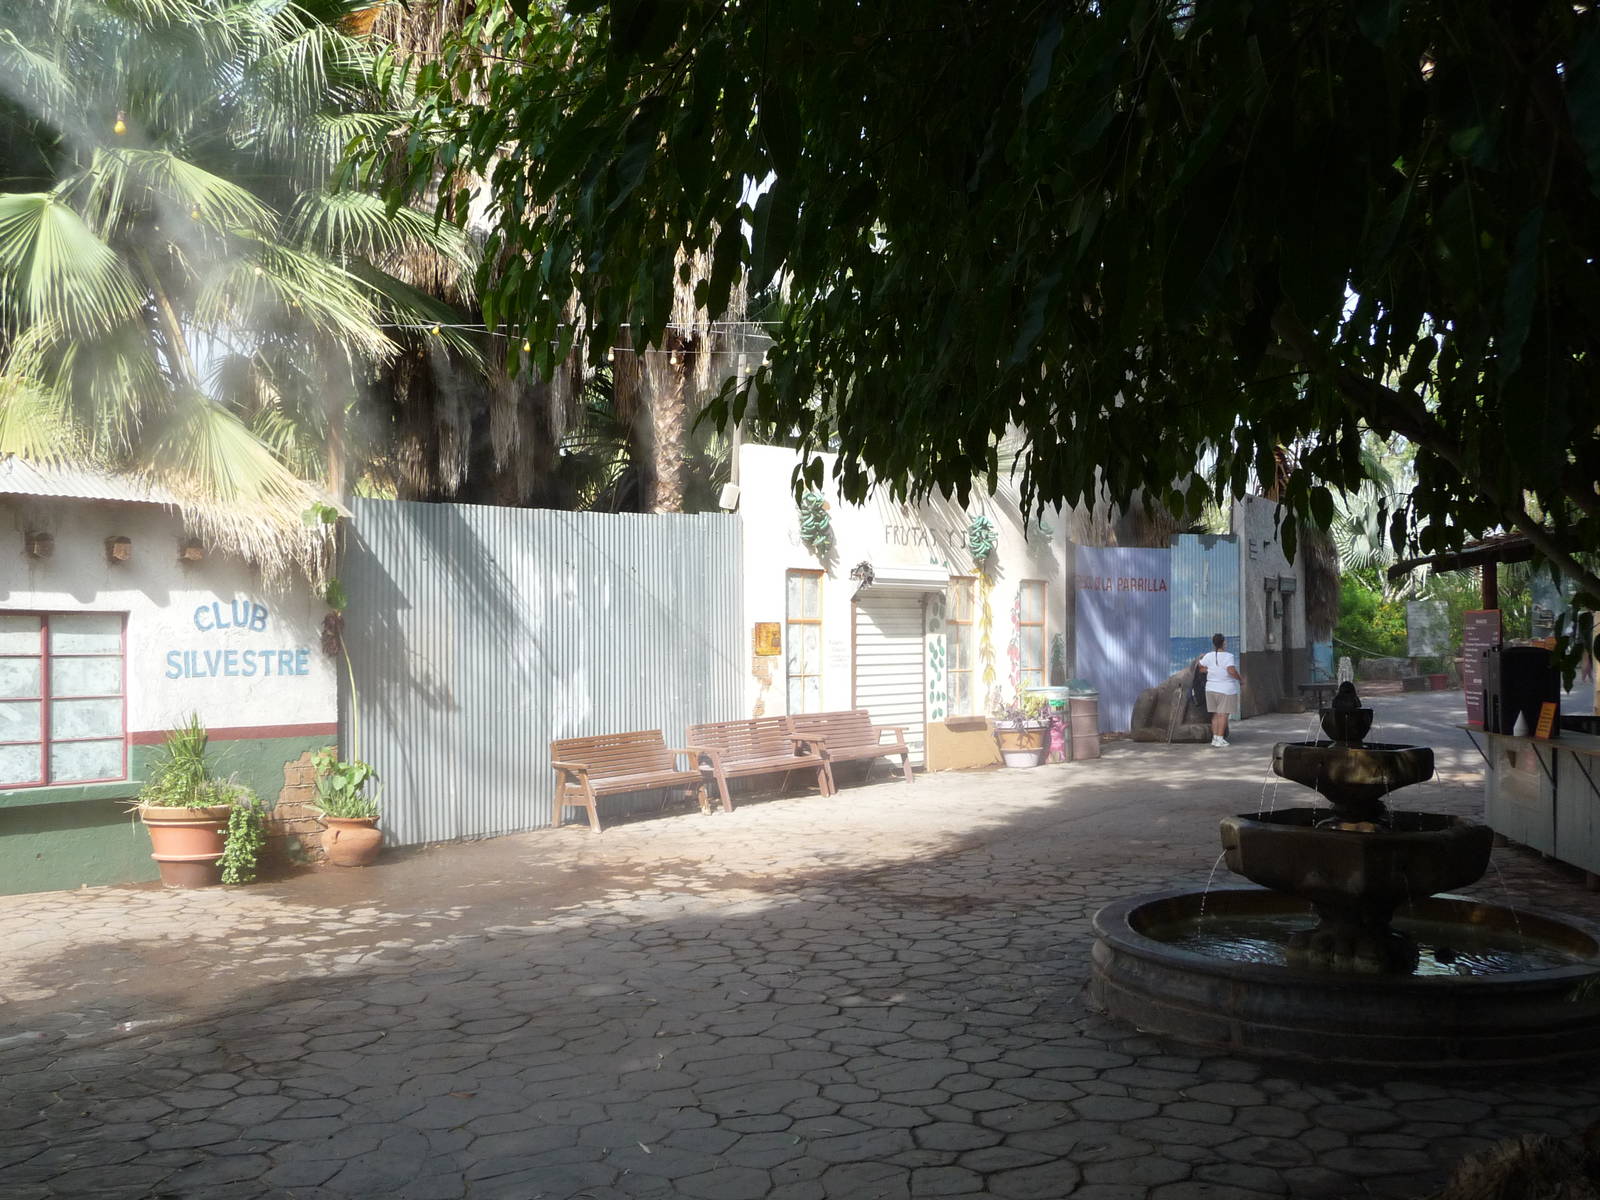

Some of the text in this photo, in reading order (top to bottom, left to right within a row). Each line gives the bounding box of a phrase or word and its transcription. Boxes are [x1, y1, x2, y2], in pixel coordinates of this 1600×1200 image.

[885, 524, 937, 547] FRUTAS
[945, 528, 955, 547] Y
[1117, 576, 1168, 592] PARRILLA
[193, 599, 269, 632] CLUB
[165, 649, 311, 679] SILVESTRE
